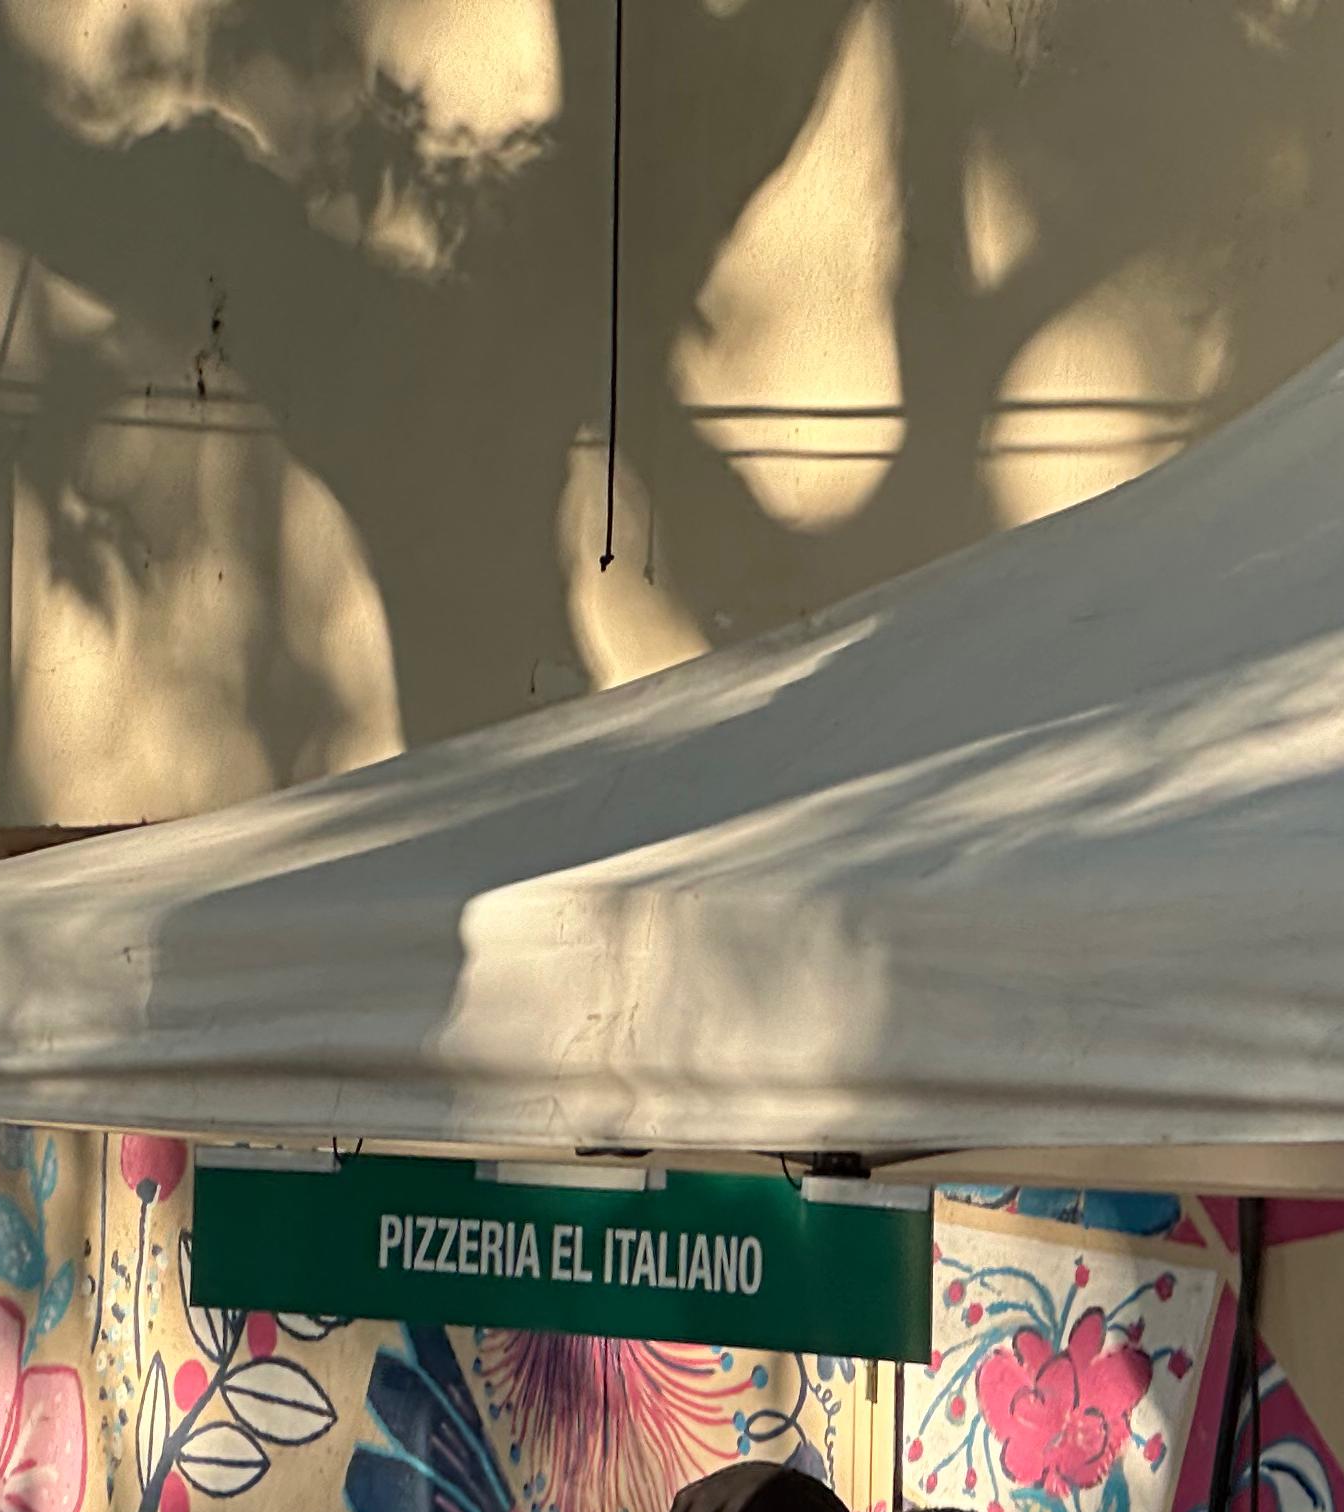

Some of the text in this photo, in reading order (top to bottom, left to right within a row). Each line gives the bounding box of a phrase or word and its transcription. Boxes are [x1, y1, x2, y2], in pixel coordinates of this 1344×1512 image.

[378, 1213, 764, 1295] PIZZERIA EL ITALIANO
